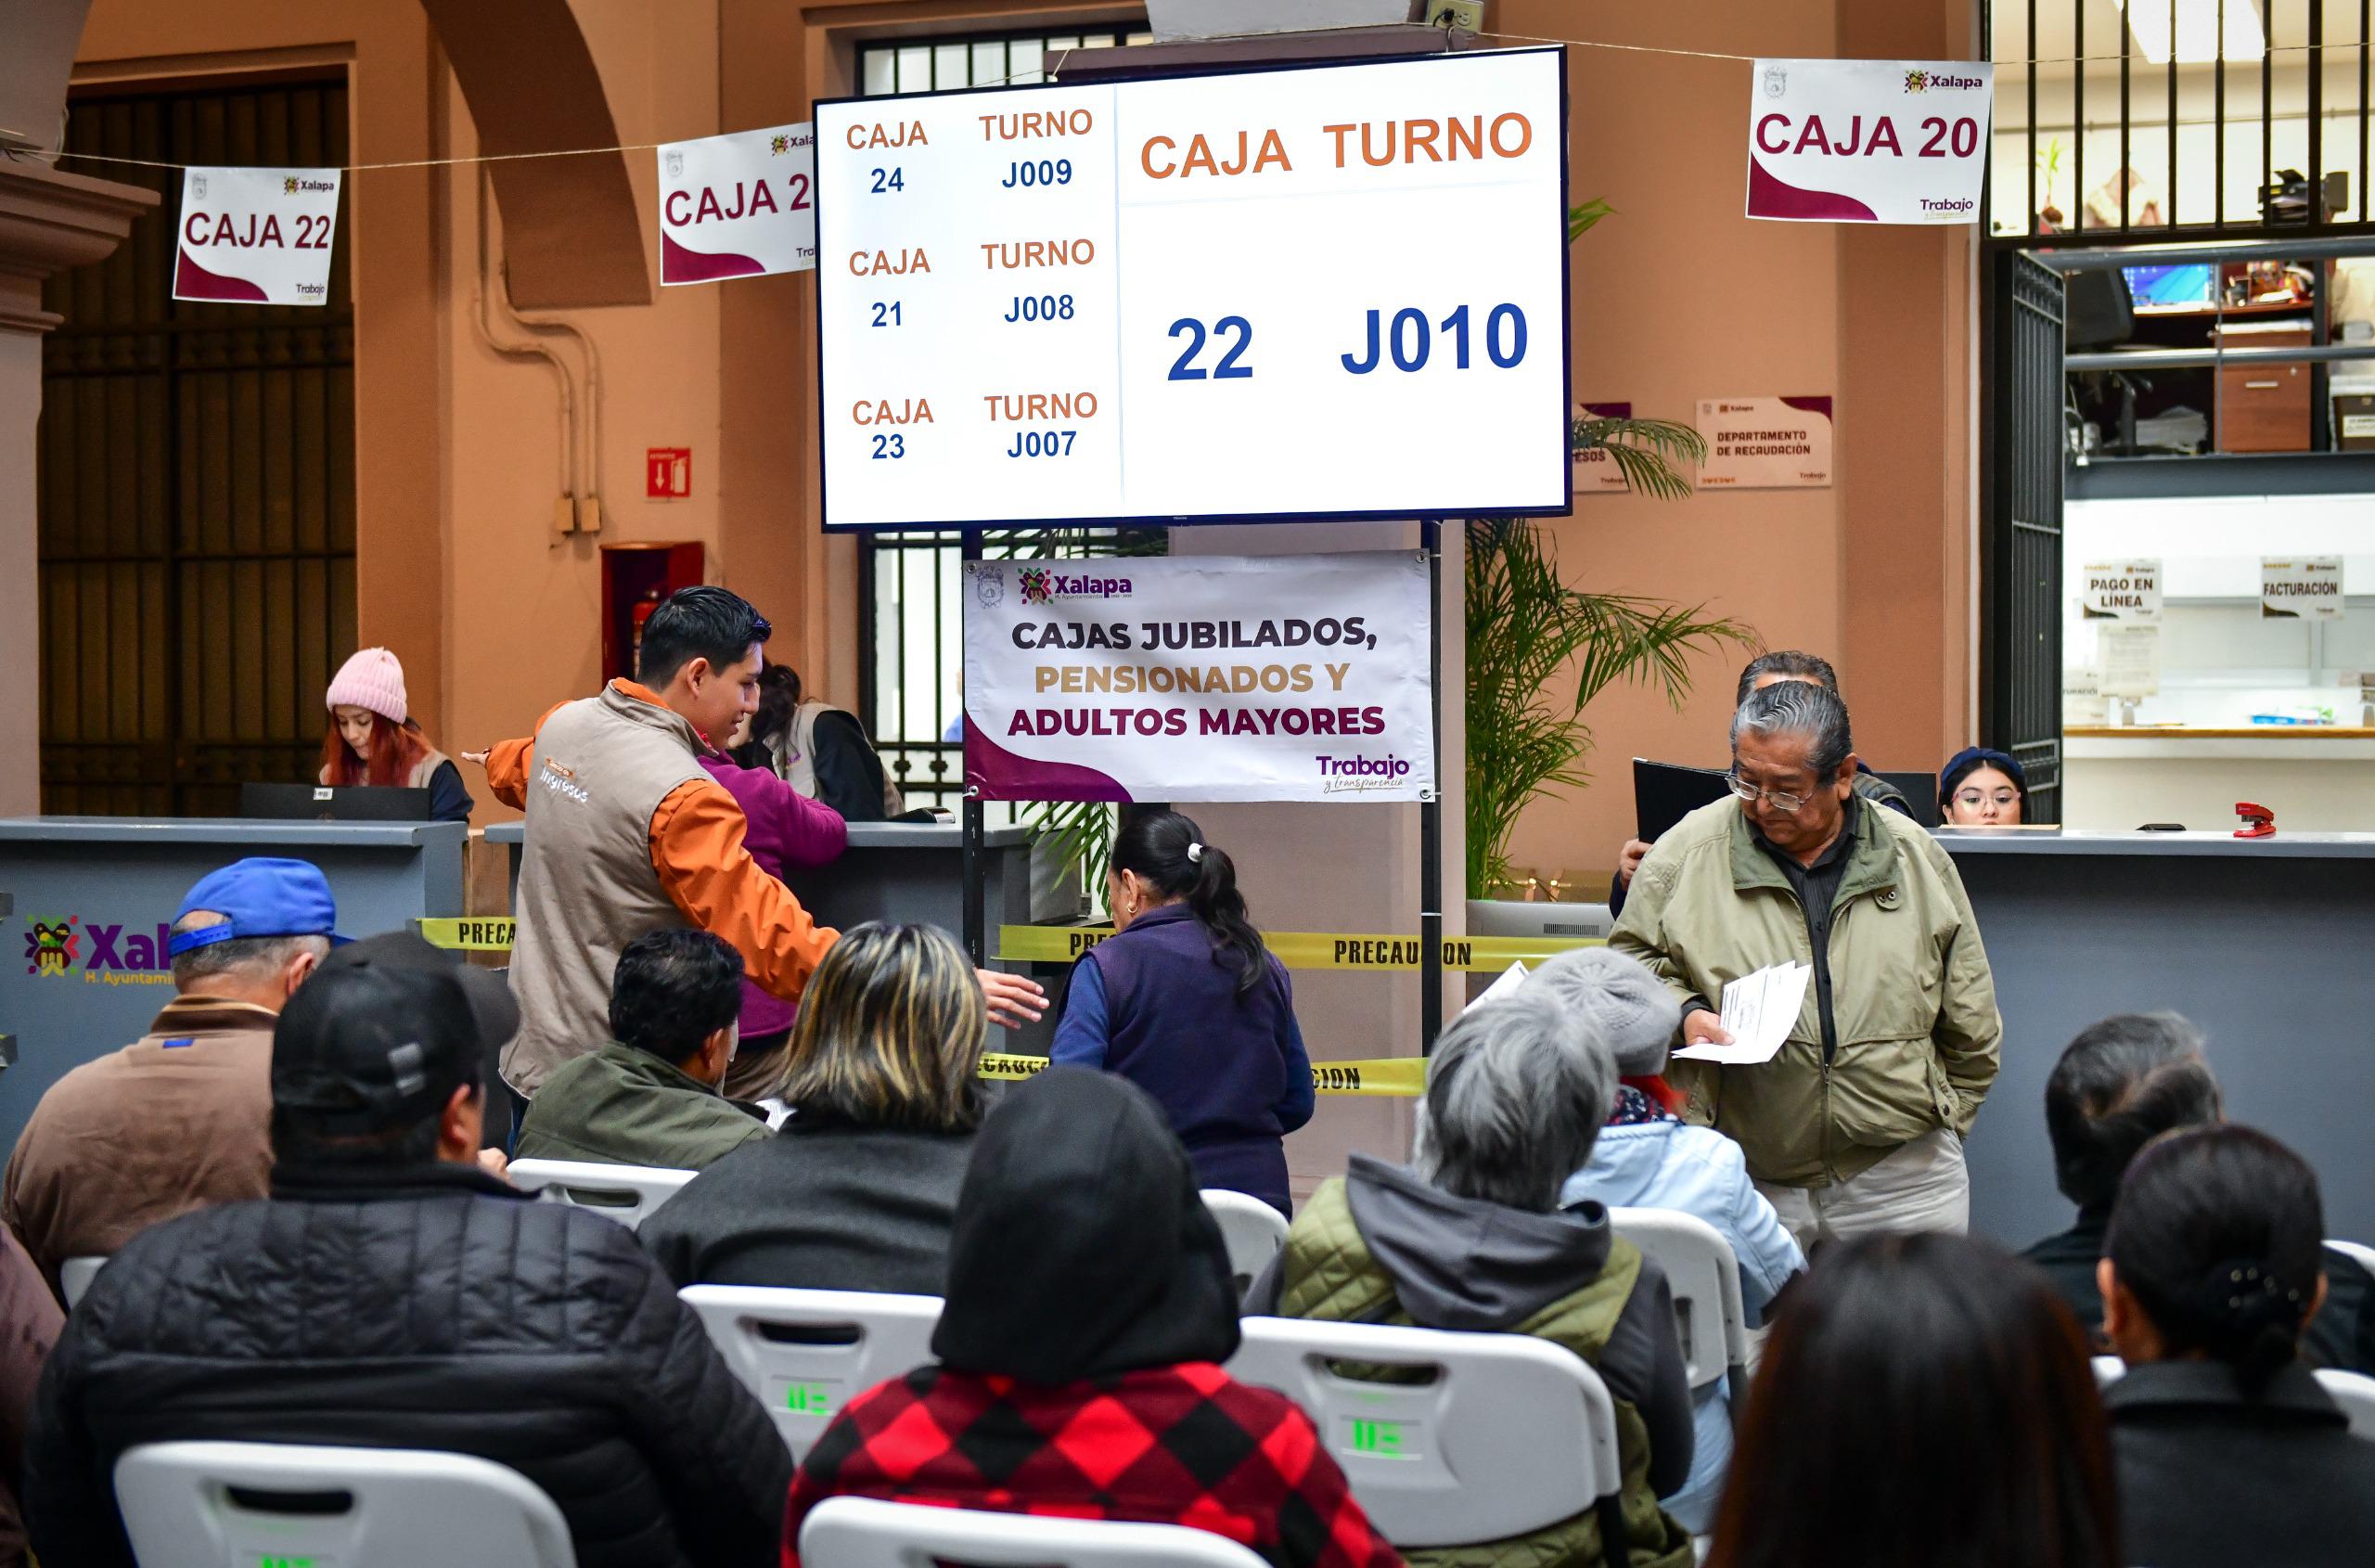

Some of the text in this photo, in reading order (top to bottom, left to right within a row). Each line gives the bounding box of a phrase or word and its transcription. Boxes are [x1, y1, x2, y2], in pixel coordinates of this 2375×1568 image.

[1930, 75, 1983, 90] Xalapa
[846, 120, 929, 150] CAJA
[979, 109, 1093, 142] TURNO
[1756, 113, 1978, 158] CAJA 20
[790, 135, 814, 148] Xala
[1140, 111, 1533, 180] CAJA TURNO
[301, 180, 335, 193] Xalapa
[870, 166, 905, 194] 24
[1001, 158, 1072, 189] J009
[665, 173, 811, 227] CAJA 2
[1919, 198, 1973, 212] Trabajo
[186, 212, 331, 249] CAJA 22
[849, 247, 931, 276] CAJA
[981, 238, 1095, 270] TURNO
[296, 283, 325, 295] Trabajo
[871, 300, 902, 328] 21
[1004, 293, 1075, 324] J008
[1167, 302, 1528, 381] 22 J010
[852, 398, 934, 426] CAJA
[983, 392, 1098, 422] TURNO
[871, 432, 905, 460] 23
[1007, 430, 1077, 458] J007
[1716, 442, 1811, 456] DE RECAUDACIÓN
[1717, 430, 1807, 443] DEPARTAMENTO
[1573, 451, 1606, 463] ESOS
[1054, 575, 1132, 599] Xalapa
[2090, 578, 2153, 591] PAGO EN
[2264, 578, 2338, 596] FACTURACIÓN
[2100, 592, 2143, 608] LÍNEA
[1011, 616, 1378, 652] CAJAS JUBILADOS,
[1034, 662, 1351, 694] PENSIONADOS Y
[1007, 704, 1386, 738] ADULTOS MAYORES
[1316, 753, 1410, 779] Trabajo
[1323, 772, 1403, 794] y transparencia
[84, 923, 172, 970] Xal
[458, 922, 517, 945] PRECA
[1334, 940, 1471, 966] PRECAUON
[84, 970, 175, 987] H. Ayuntami
